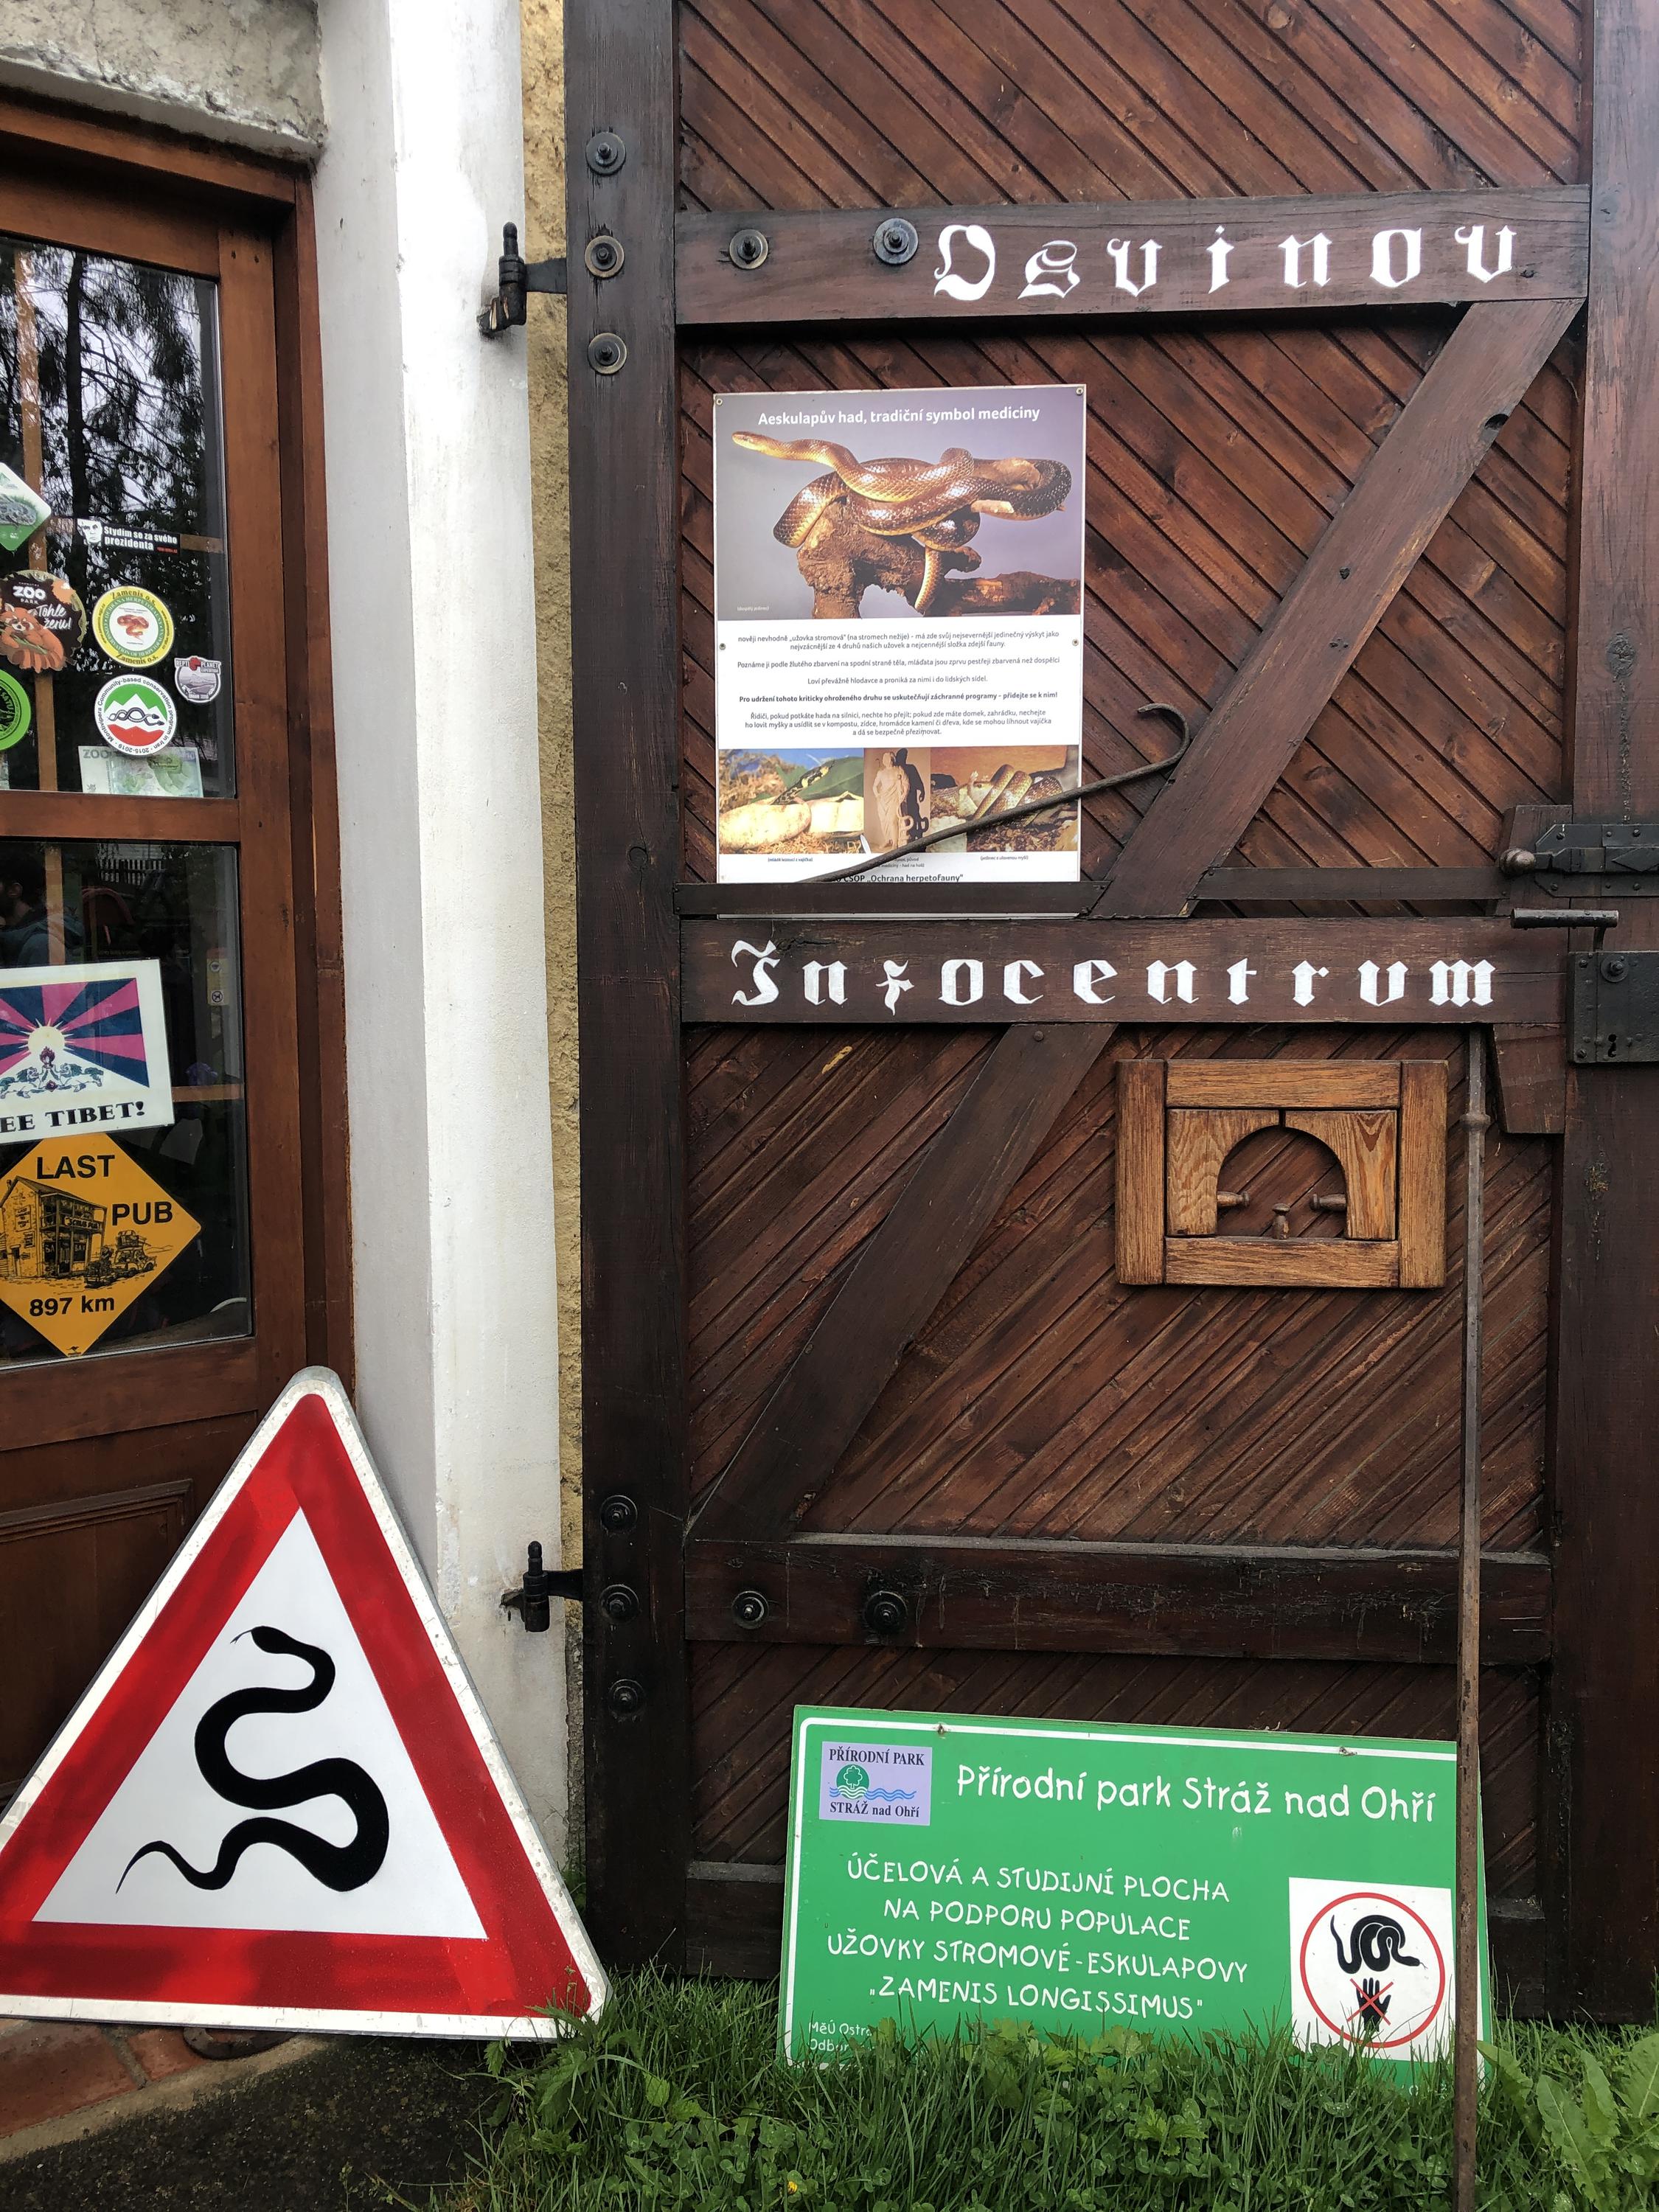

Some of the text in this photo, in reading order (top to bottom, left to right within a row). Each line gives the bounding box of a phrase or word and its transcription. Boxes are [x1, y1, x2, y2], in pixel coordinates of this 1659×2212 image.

[934, 225, 1517, 301] Osvinov
[759, 411, 835, 427] Aeskulapův
[838, 411, 866, 424] had,
[871, 409, 923, 422] tradiční
[926, 408, 974, 424] symbol
[104, 526, 132, 538] Stydím
[133, 532, 143, 540] se
[154, 534, 177, 545] svého
[105, 537, 153, 552] prezidenta
[13, 585, 46, 599] ZOO
[111, 590, 143, 599] Zamenis
[36, 603, 66, 617] Tohle
[44, 617, 72, 629] žeru!
[737, 634, 757, 644] nověji
[757, 633, 787, 641] nevhodně
[858, 632, 888, 640] stromech
[926, 631, 937, 639] zde
[938, 631, 951, 640] svůj
[993, 630, 1024, 639] jedinečný
[1024, 630, 1045, 639] výskyt
[1045, 630, 1059, 639] jako
[790, 641, 827, 651] nejvzácnější
[841, 641, 860, 649] druhů
[883, 640, 905, 648] užovek
[911, 640, 947, 650] nejcennější
[947, 639, 967, 647] složka
[967, 639, 986, 649] zdejší
[987, 639, 1005, 648] fauny.
[115, 653, 159, 664] Zamenis o.s.
[737, 660, 765, 668] Poznáme
[771, 659, 788, 669] podle
[789, 659, 813, 667] žlutého
[813, 658, 840, 667] zbarvení
[849, 658, 871, 667] spodní
[872, 658, 892, 666] straně
[892, 658, 906, 667] těla,
[934, 657, 947, 667] jsou
[1021, 655, 1032, 664] než
[807, 676, 820, 684] Loví
[821, 676, 849, 686] převážně
[850, 675, 877, 684] hlodavce
[884, 675, 908, 685] proniká
[945, 675, 970, 684] lidských
[97, 678, 142, 706] Community-based
[143, 680, 172, 709] conservation
[739, 695, 750, 703] Pro
[751, 695, 775, 703] udržení
[776, 694, 798, 702] tohoto
[799, 694, 823, 703] kriticky
[824, 693, 861, 701] ohroženého
[891, 692, 930, 702] uskutečňují
[930, 692, 964, 700] záchranné
[965, 693, 997, 701] programy
[1003, 691, 1028, 700] přidejte
[751, 712, 768, 721] Řidiči,
[770, 712, 789, 720] pokud
[790, 712, 814, 720] potkáte
[815, 711, 830, 719] hada
[841, 711, 860, 720] silnici,
[861, 710, 883, 718] nechte
[912, 710, 932, 719] pokud
[933, 709, 944, 717] zde
[945, 709, 961, 717] máte
[987, 709, 1018, 718] zahrádku,
[1018, 709, 1046, 717] nechejte
[754, 720, 767, 728] lovit
[768, 720, 788, 729] myšky
[793, 720, 813, 728] usídlit
[860, 719, 877, 728] zídce,
[911, 718, 934, 726] kamení
[942, 718, 961, 727] dřeva,
[983, 717, 1005, 726] mohou
[1029, 717, 1051, 726] vajíčka
[874, 728, 904, 737] bezpečně
[153, 741, 164, 749] Iran
[45, 1102, 145, 1127] TIBET!
[38, 1155, 114, 1179] LAST
[113, 1202, 173, 1225] PUB
[29, 1295, 114, 1316] 897 km
[830, 1746, 924, 1765] PŘÍRODNÍ PARK
[958, 1764, 1436, 1822] Přírodní park Stráž nad Ohří
[830, 1801, 919, 1817] STRÁŽ nad Ohří
[848, 1852, 1229, 1902] ÚČELOVÁ A STUDIJNÍ PLOCHA
[884, 1899, 1190, 1940] NA PODPORU POPULACE
[828, 1928, 925, 1960] UŽOVKY
[809, 2019, 835, 2035] MěÚ
